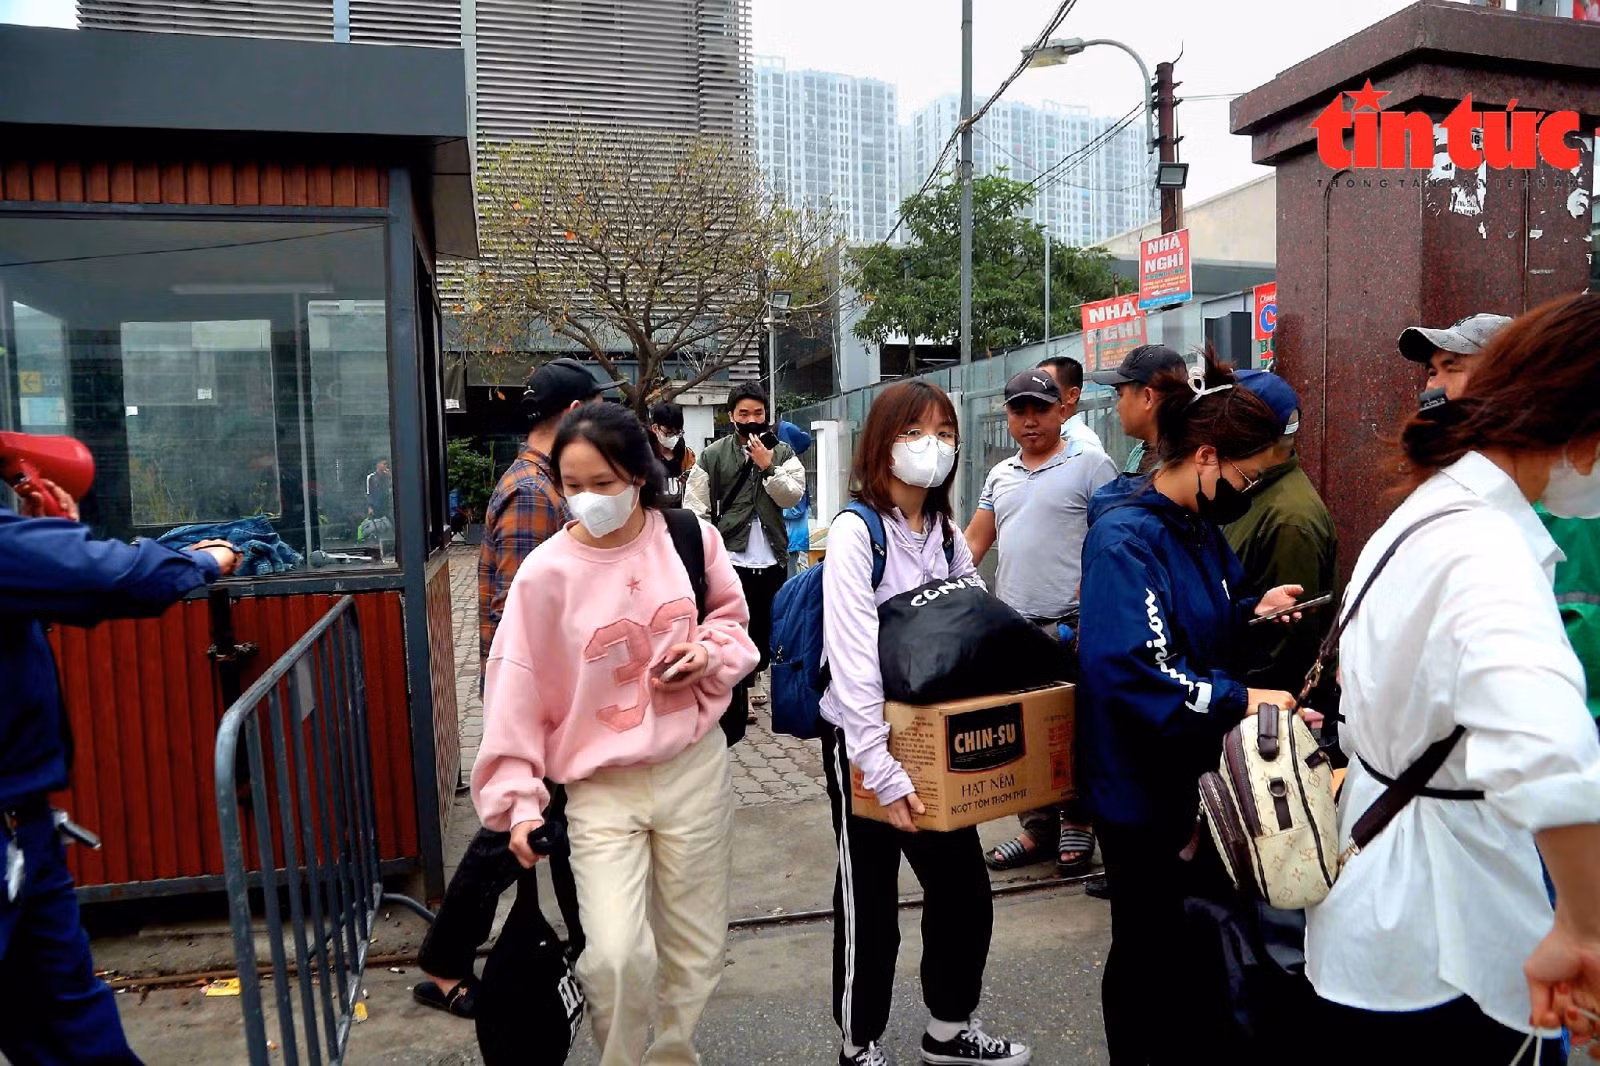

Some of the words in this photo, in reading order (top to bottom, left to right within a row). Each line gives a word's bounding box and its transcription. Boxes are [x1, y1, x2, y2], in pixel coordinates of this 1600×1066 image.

[1147, 233, 1181, 255] NHÀ
[1144, 247, 1184, 274] NGHỈ
[1089, 299, 1137, 324] NHÀ
[954, 722, 1016, 755] CHIN-SU
[961, 780, 986, 798] HẠT
[990, 773, 1015, 791] NÊM
